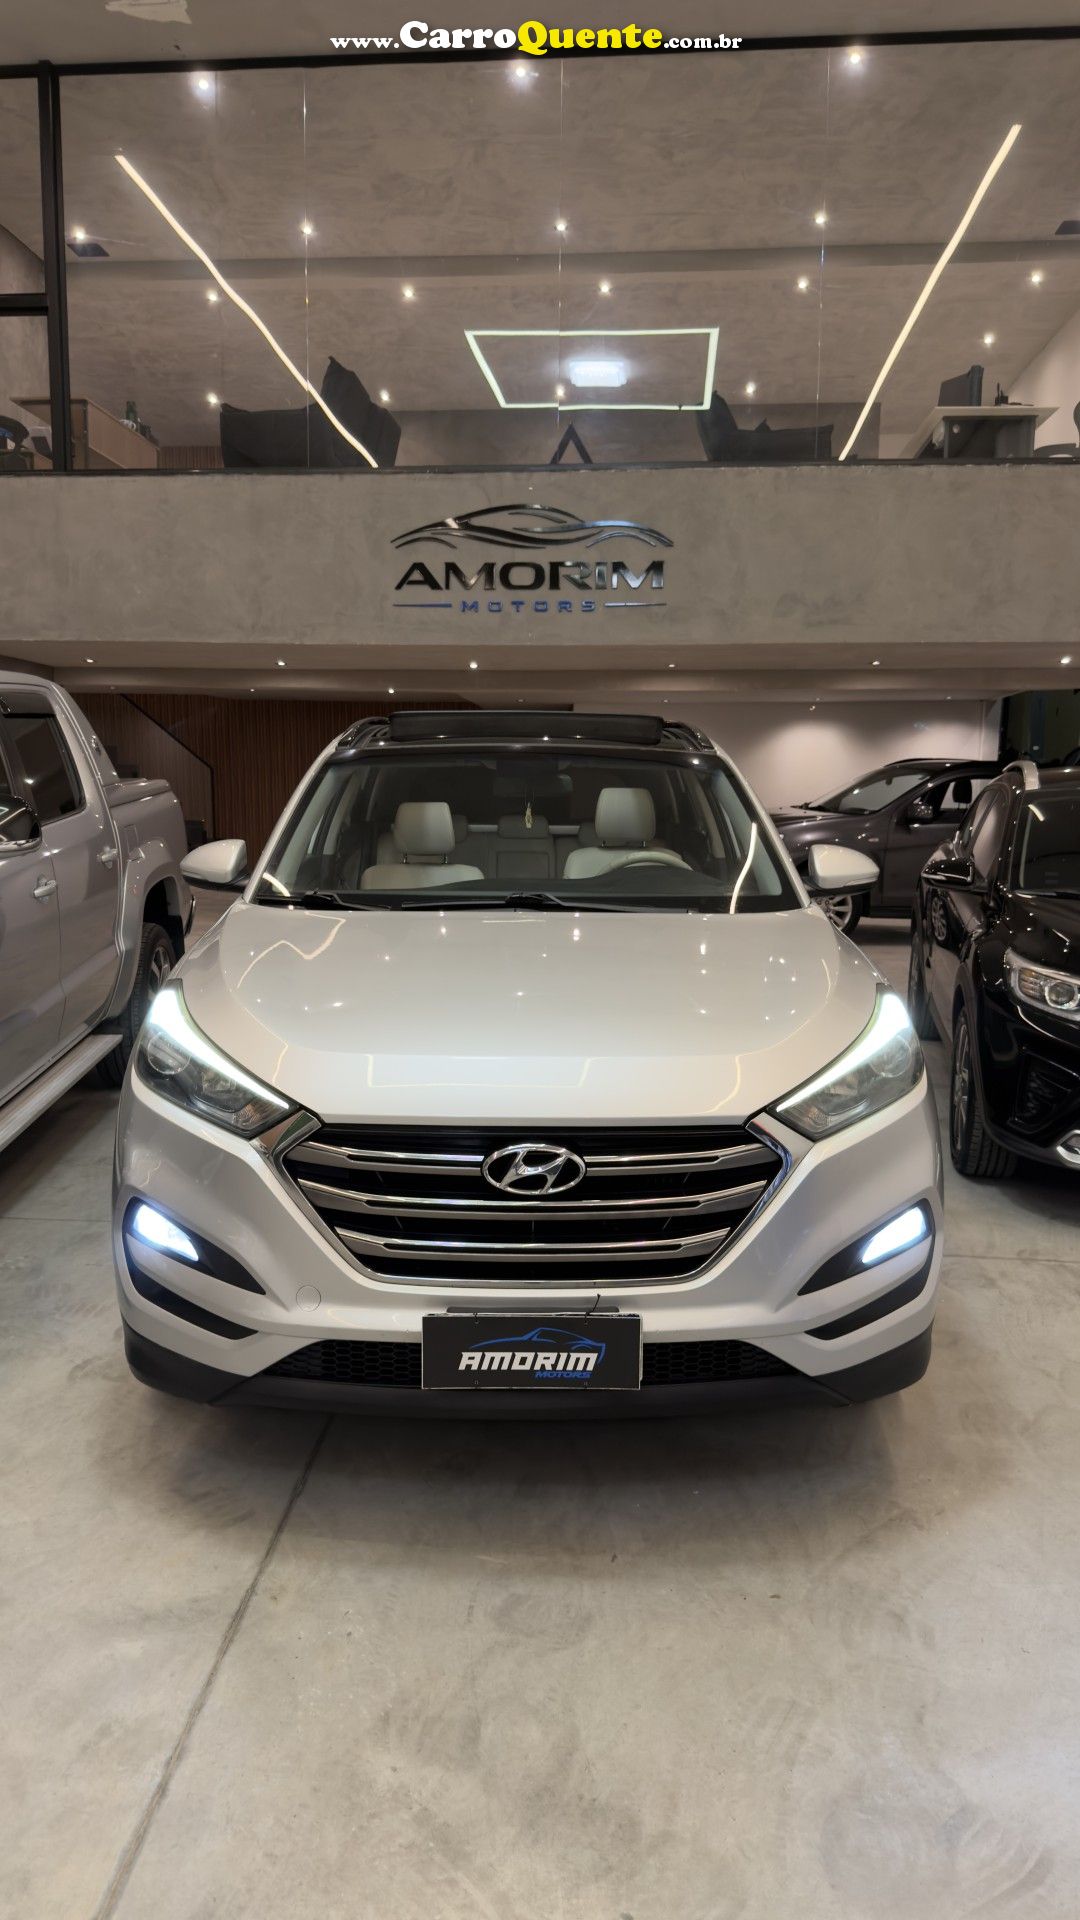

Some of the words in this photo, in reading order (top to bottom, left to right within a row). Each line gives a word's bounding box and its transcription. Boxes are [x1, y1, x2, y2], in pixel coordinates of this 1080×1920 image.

[394, 560, 665, 591] AMORIM
[461, 599, 596, 613] MOTORS
[458, 1351, 599, 1371] AMORIM
[534, 1370, 593, 1379] MOTORS
